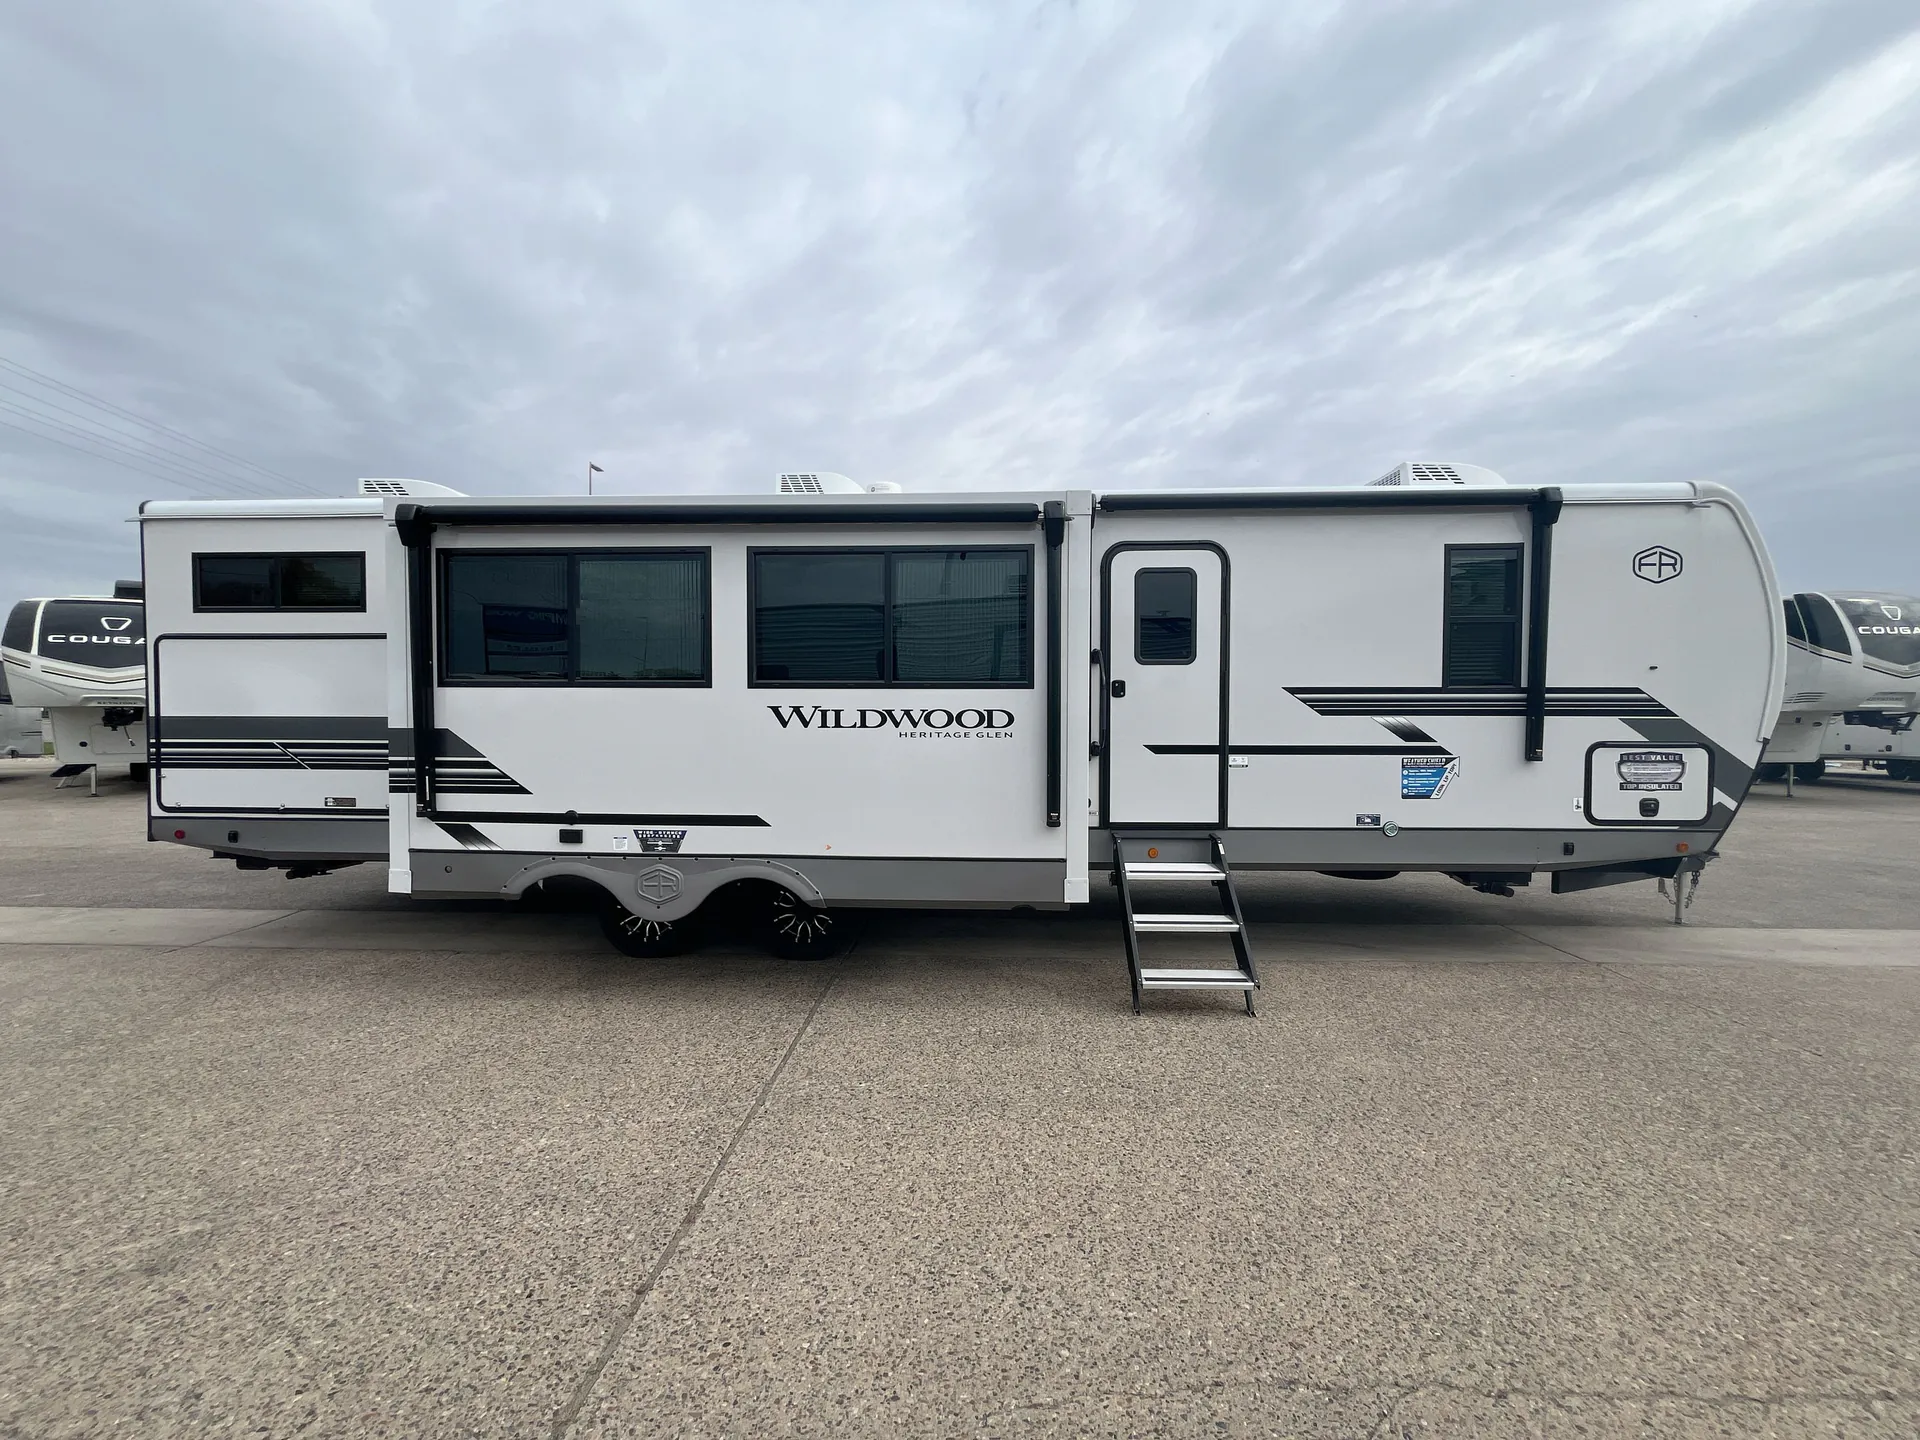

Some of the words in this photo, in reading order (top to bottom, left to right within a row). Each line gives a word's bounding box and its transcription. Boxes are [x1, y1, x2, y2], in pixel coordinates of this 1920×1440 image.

[767, 705, 1015, 729] WILDWOOD
[899, 731, 971, 739] HERITAGE
[976, 731, 1014, 739] GLEN
